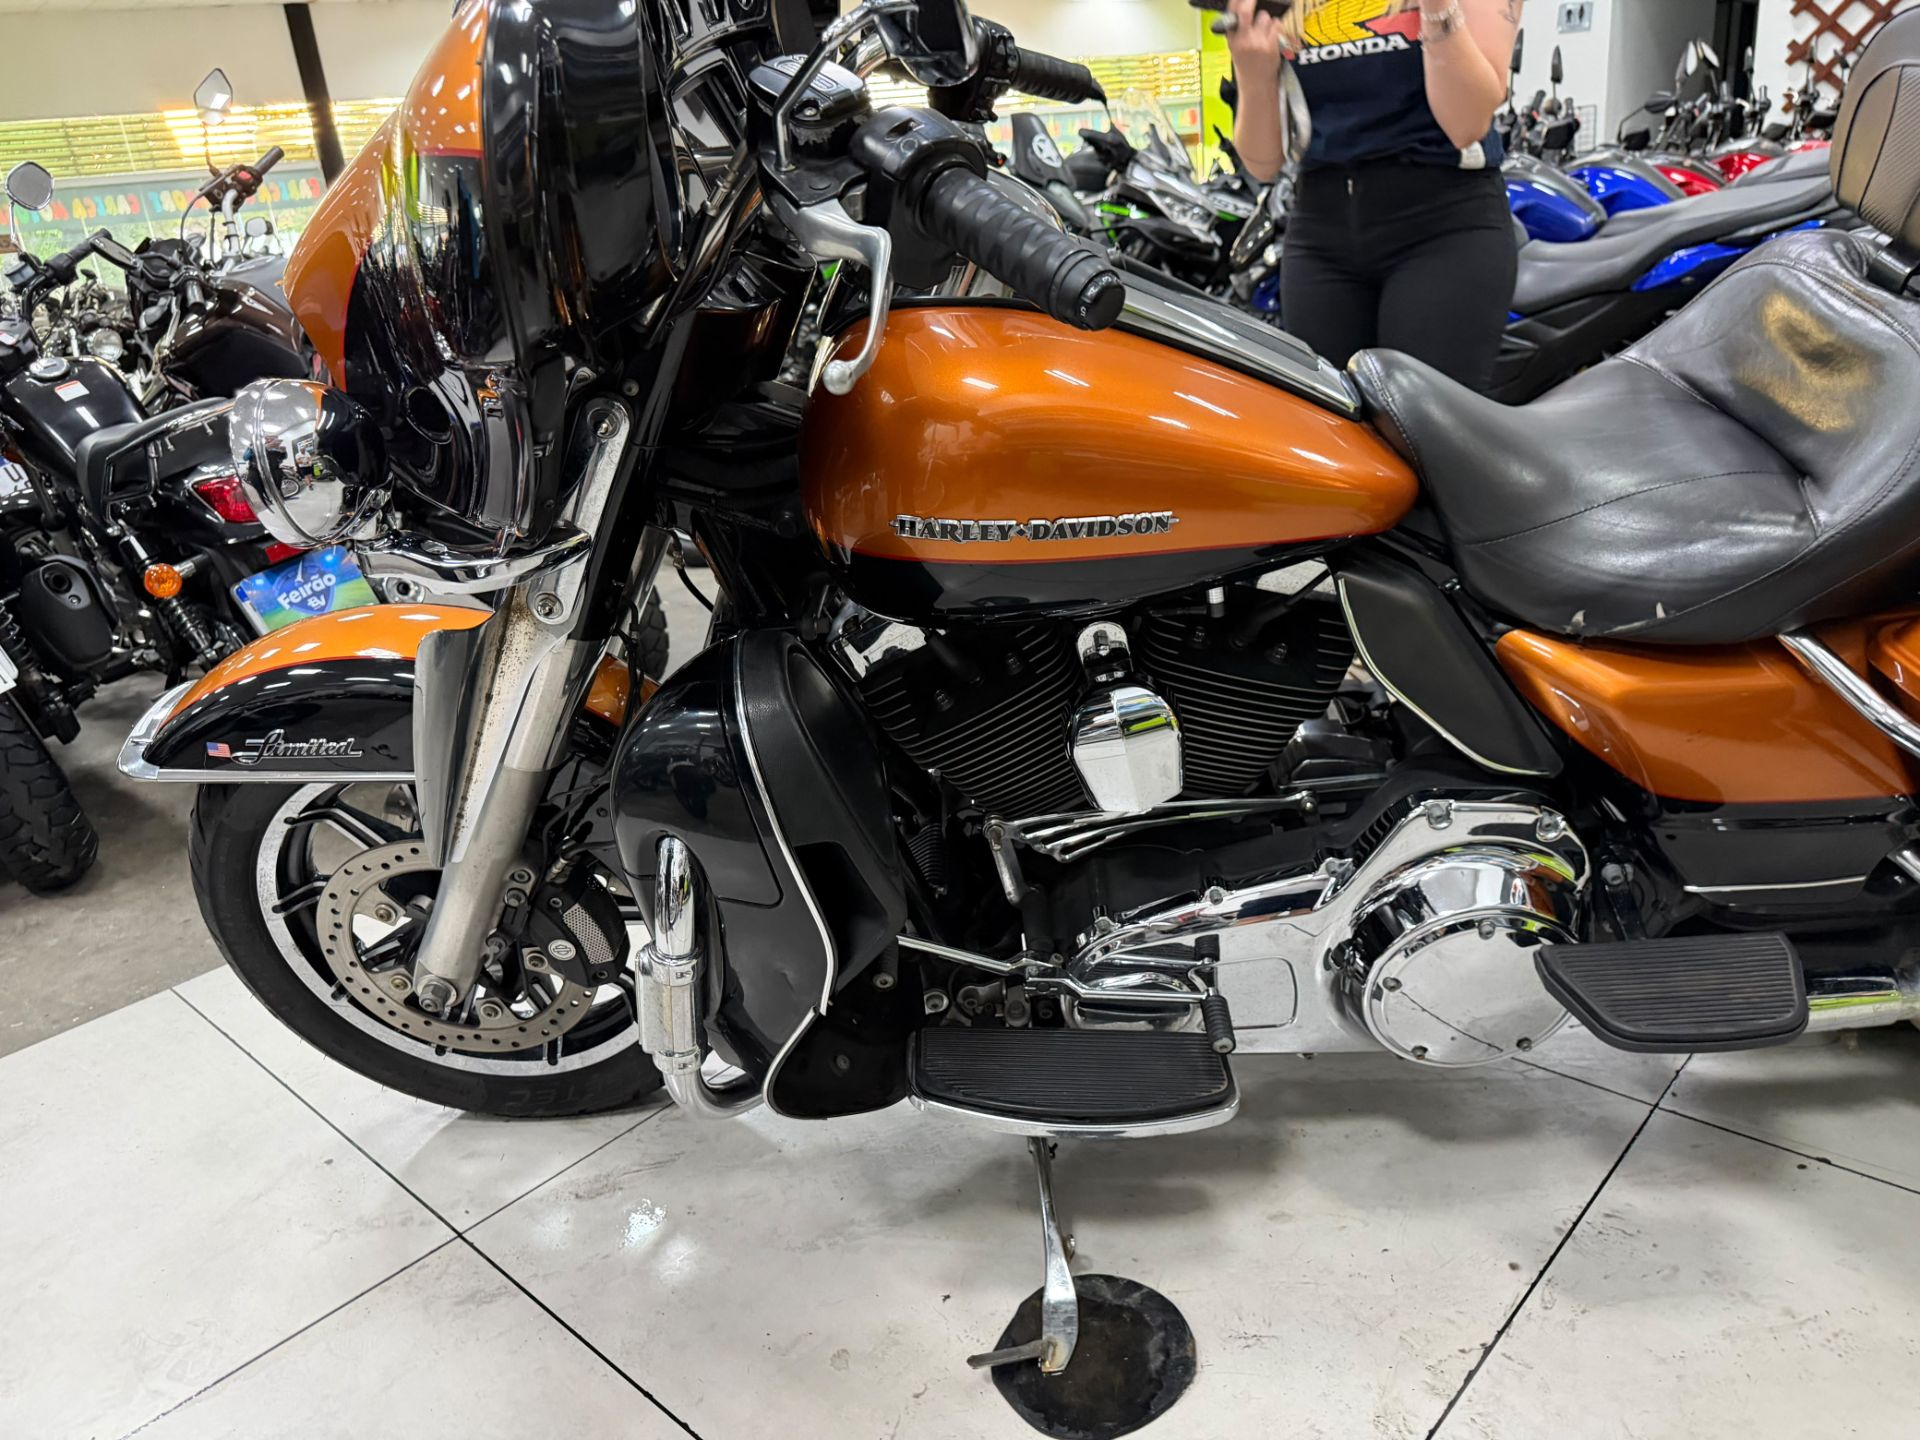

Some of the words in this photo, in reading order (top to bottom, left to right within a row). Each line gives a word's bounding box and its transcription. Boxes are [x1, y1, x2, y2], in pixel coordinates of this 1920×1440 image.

[1298, 33, 1411, 65] HONDA
[277, 573, 336, 610] Feirão
[231, 729, 363, 766] Limited
